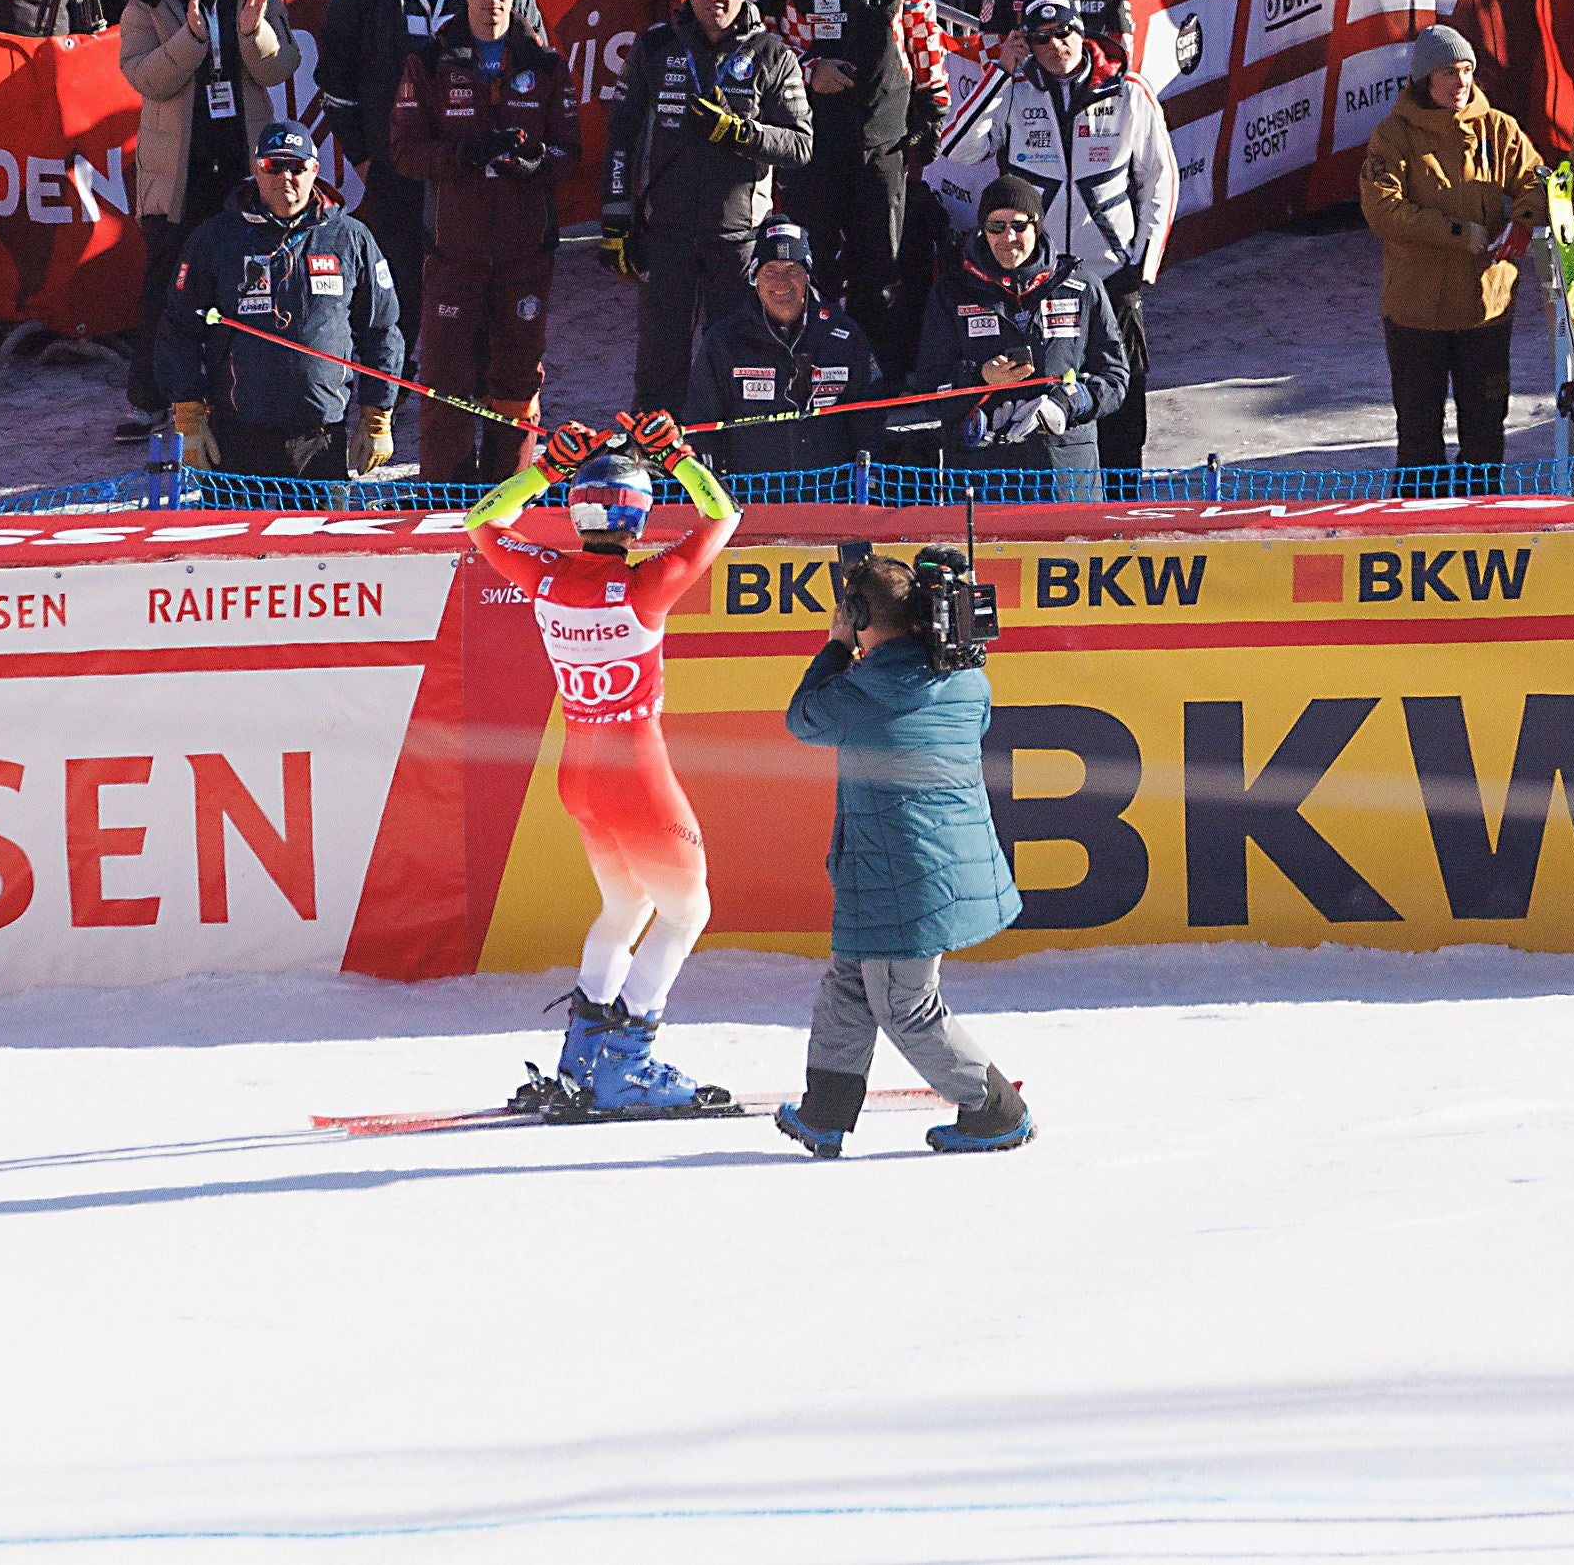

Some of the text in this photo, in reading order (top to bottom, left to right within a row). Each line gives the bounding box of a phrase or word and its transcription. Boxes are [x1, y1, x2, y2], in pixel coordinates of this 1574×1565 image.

[666, 56, 688, 66] EA7
[1244, 97, 1312, 144] OCHSNER
[284, 133, 304, 147] 5G
[1243, 127, 1289, 164] SPORT
[311, 258, 335, 271] HH
[315, 279, 340, 292] DNB
[239, 303, 269, 314] KPMG
[768, 411, 801, 423] LEKI
[1037, 555, 1207, 608] BKW
[1358, 548, 1531, 603] BKW
[148, 582, 383, 624] RAIFFEISEN
[550, 619, 630, 643] Sunrise
